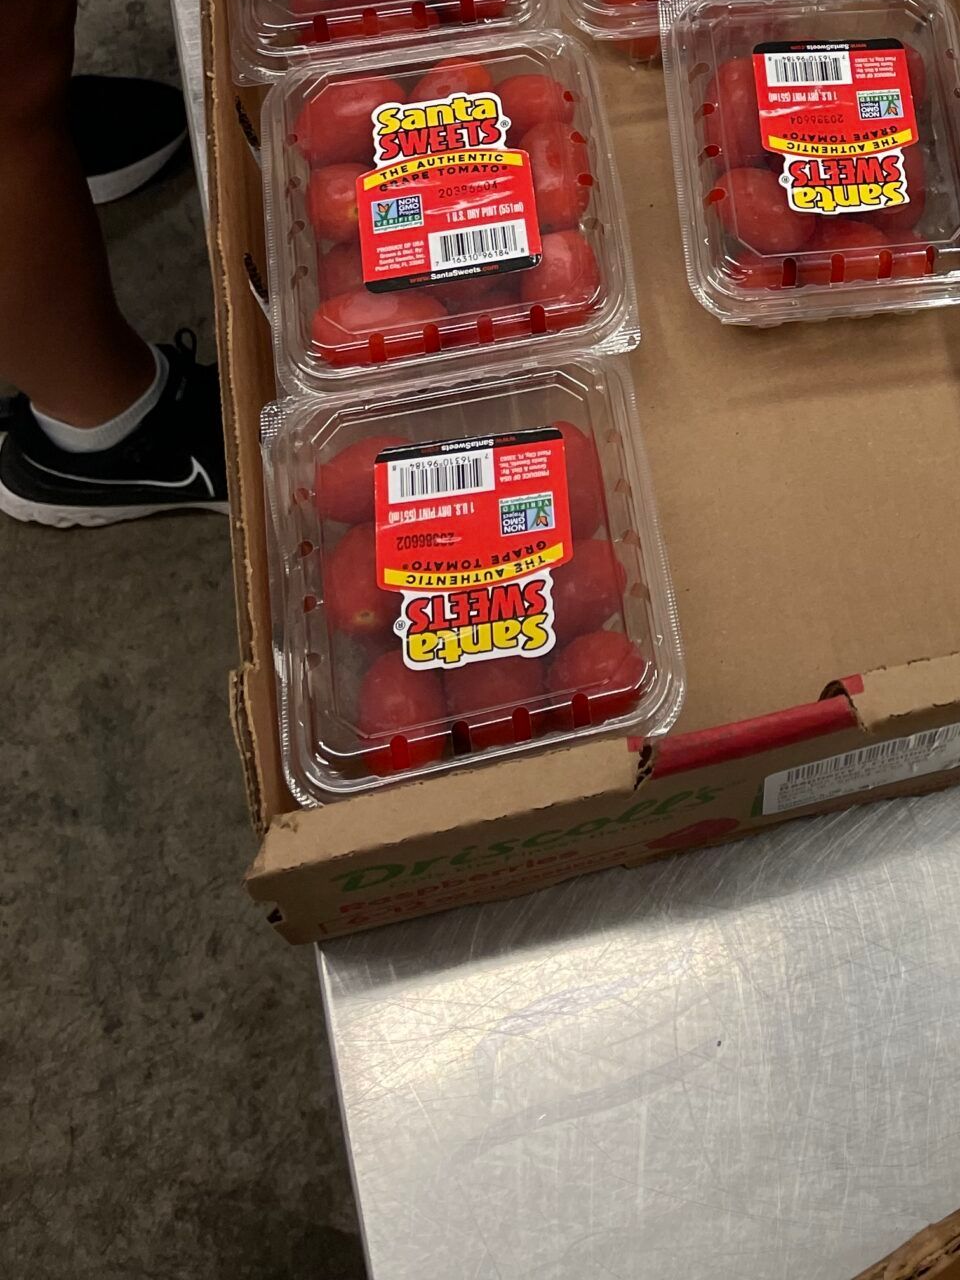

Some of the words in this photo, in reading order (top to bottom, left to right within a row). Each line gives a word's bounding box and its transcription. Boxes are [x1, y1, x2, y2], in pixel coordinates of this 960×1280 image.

[376, 96, 497, 135] Santa
[377, 118, 502, 160] SWEETS
[852, 125, 897, 140] GRAPE
[786, 142, 864, 153] AUTHENTIC
[872, 137, 897, 149] THE
[379, 163, 408, 179] THE
[417, 153, 503, 167] AUTHENTIC
[788, 155, 901, 188] SWEETS
[398, 196, 418, 205] NON
[791, 181, 904, 212] Santa
[398, 202, 419, 211] GMO
[446, 213, 450, 222] 1
[451, 211, 465, 221] U.S.
[466, 208, 479, 219] DRY
[481, 205, 497, 216] PINT
[375, 214, 420, 226] VERIFIED
[451, 253, 478, 263] 16310
[482, 248, 509, 259] 96184
[409, 459, 438, 470] 96184
[442, 455, 471, 466] 16310
[522, 469, 549, 478] PRODUCE
[436, 504, 452, 517] DRY
[453, 502, 468, 514] U.S.
[469, 501, 474, 512] 1
[501, 498, 549, 511] VERIFIED
[387, 507, 416, 524] (551ml)
[418, 506, 435, 519] PINT
[502, 510, 524, 518] Project
[502, 516, 524, 525] GMO
[503, 523, 524, 531] NON
[490, 540, 546, 562] GRAPE
[513, 554, 545, 573] THE
[404, 568, 504, 583] AUTHENTIC
[405, 580, 546, 633] SWEETS
[406, 614, 549, 664] Santa
[333, 783, 722, 893] Driscoll's
[339, 849, 578, 915] Raspberries
